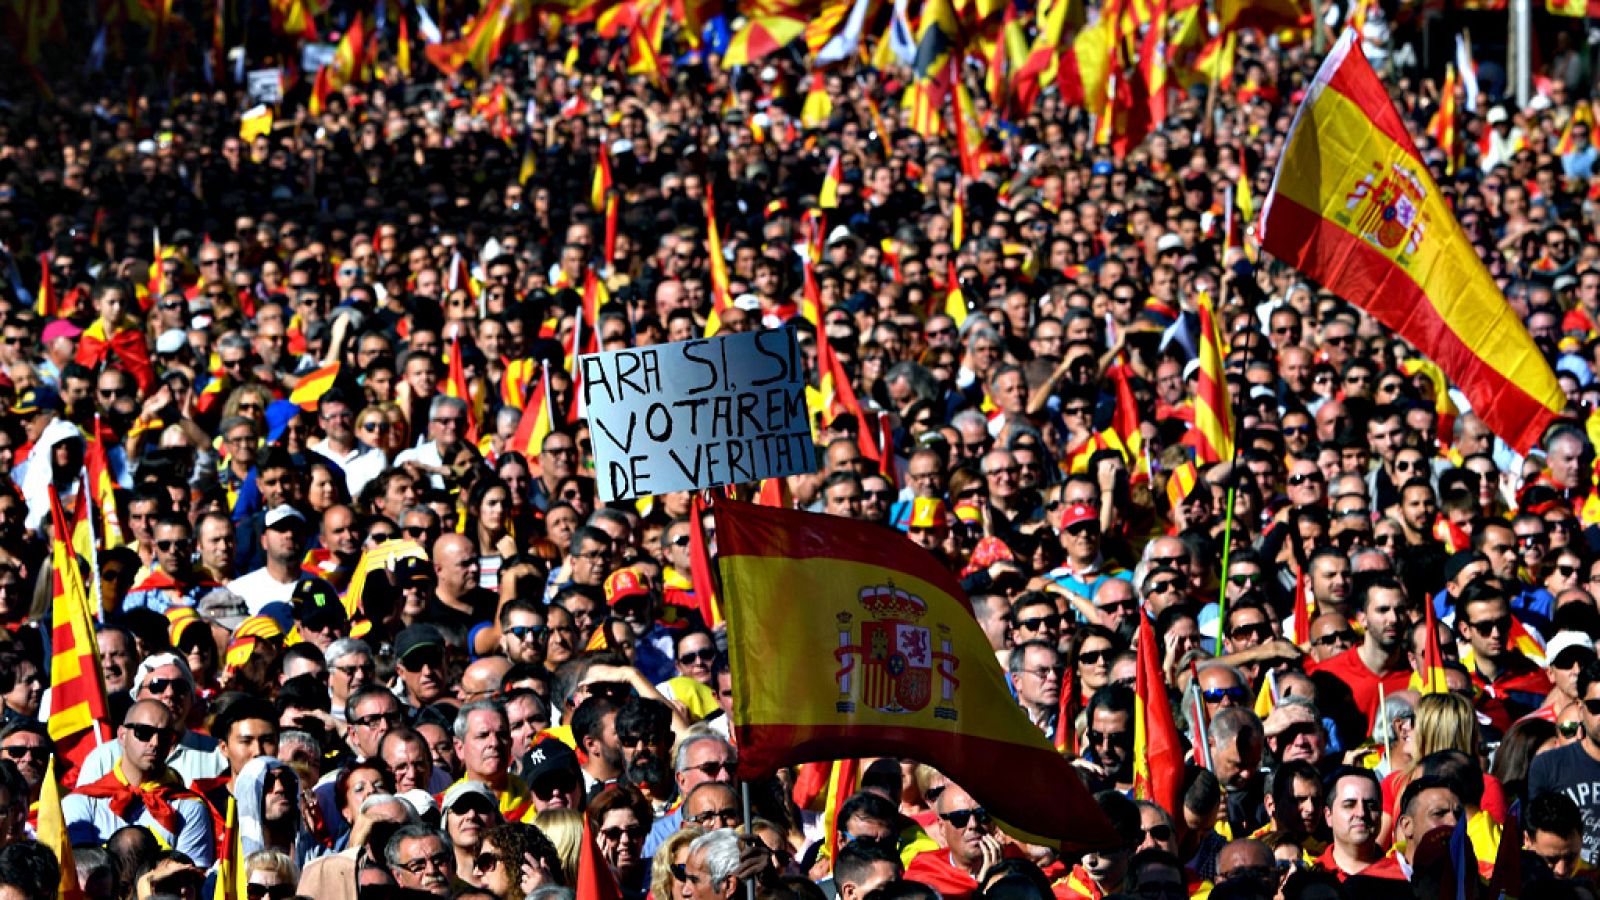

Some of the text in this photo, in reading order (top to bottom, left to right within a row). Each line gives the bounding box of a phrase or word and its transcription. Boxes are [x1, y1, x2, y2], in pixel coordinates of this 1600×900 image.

[582, 350, 662, 406] ARA
[751, 327, 798, 387] SI
[596, 388, 811, 454] VOTAREM
[609, 431, 812, 501] DE VERITAT
